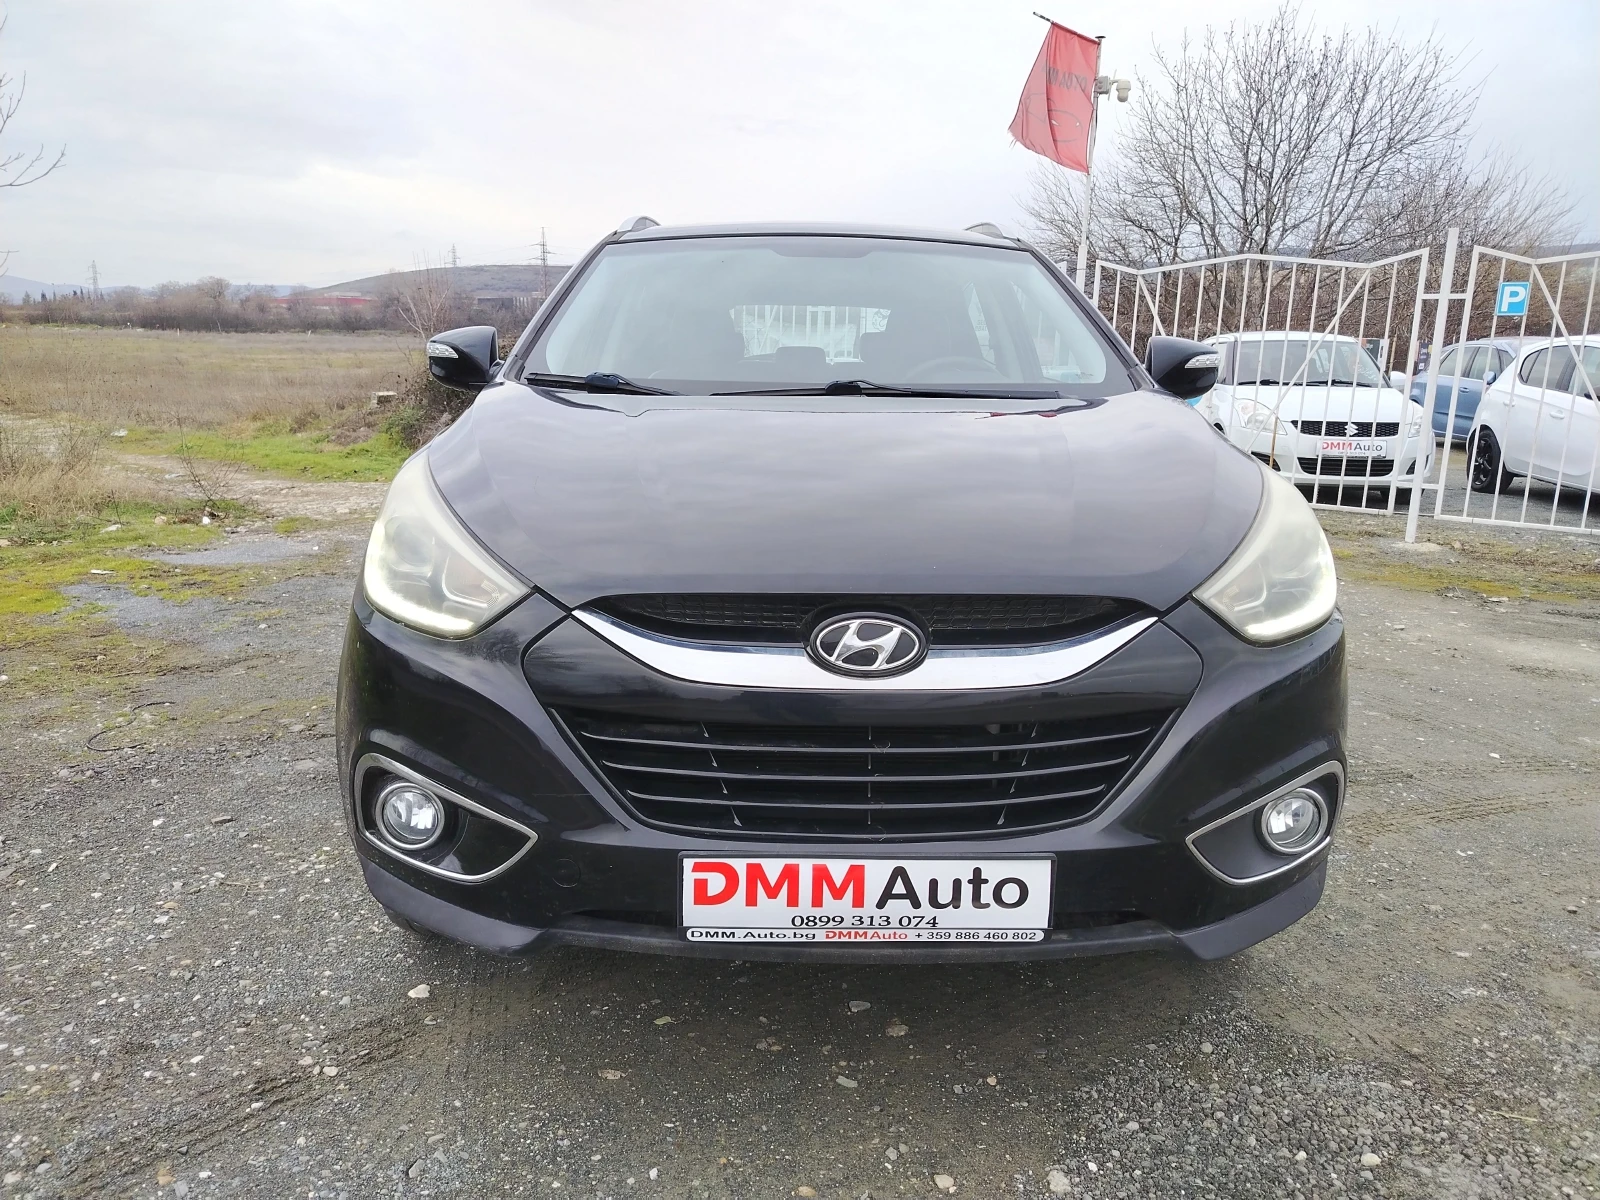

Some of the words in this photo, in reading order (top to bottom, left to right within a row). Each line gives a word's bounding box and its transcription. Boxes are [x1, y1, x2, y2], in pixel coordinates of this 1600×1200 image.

[1501, 286, 1526, 312] P
[791, 915, 845, 927] 0899
[851, 915, 892, 927] 313
[898, 915, 939, 928] 074
[690, 930, 816, 941] DMM.Auto.bg
[955, 931, 980, 940] 886
[983, 931, 1008, 940] 460
[1012, 931, 1037, 940] 802
